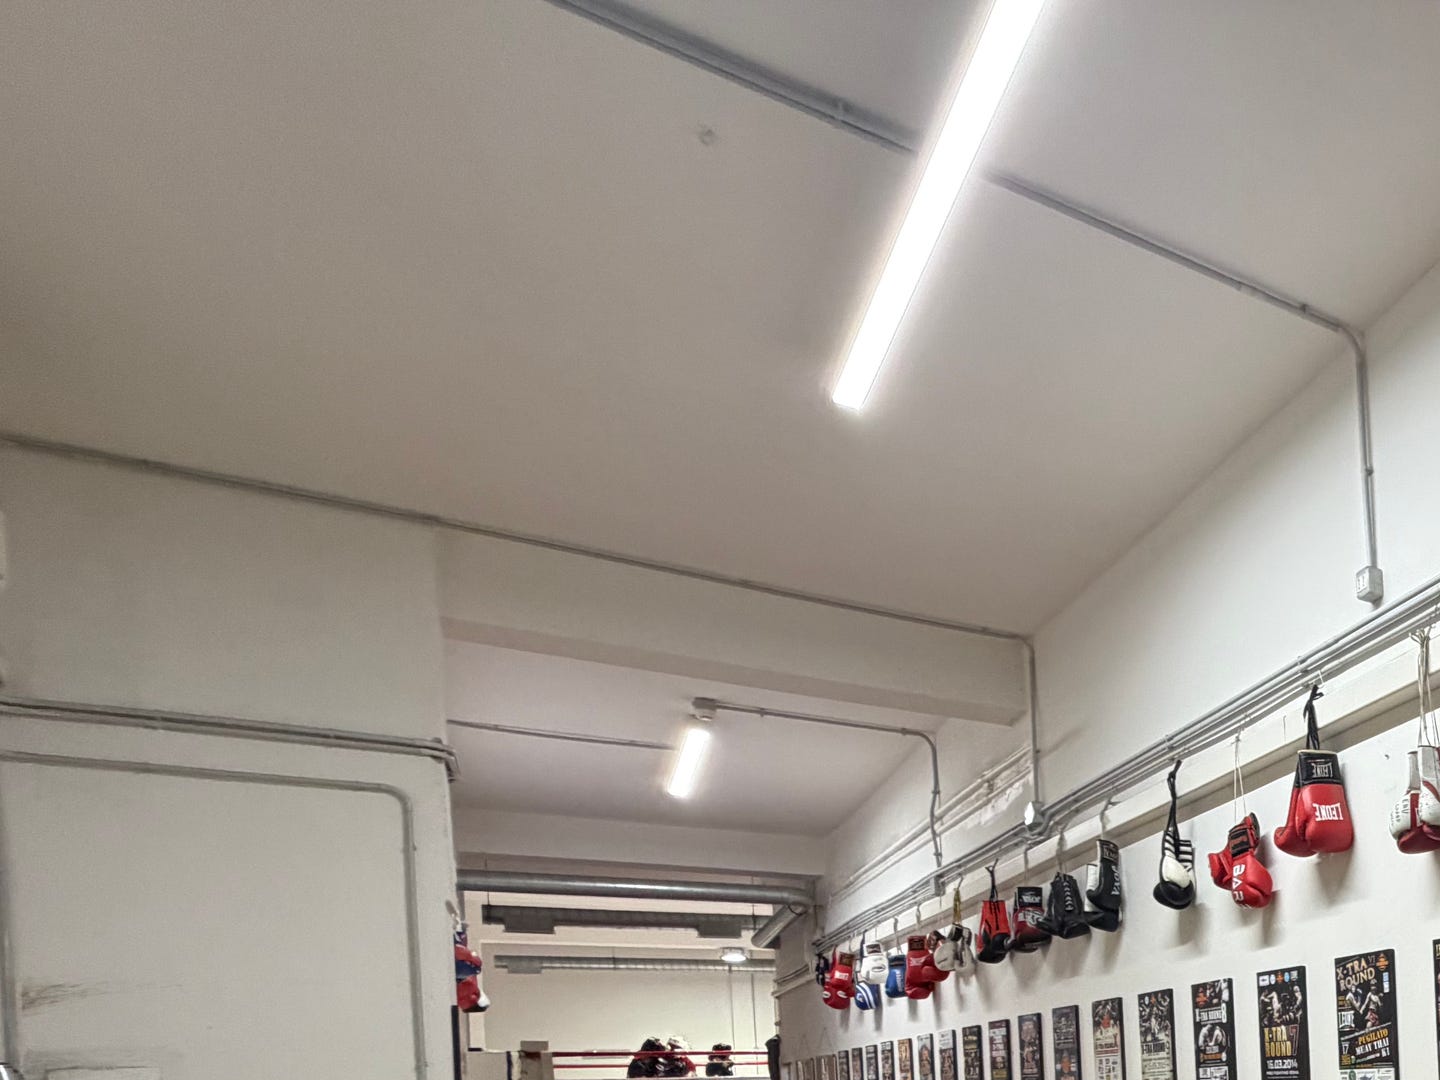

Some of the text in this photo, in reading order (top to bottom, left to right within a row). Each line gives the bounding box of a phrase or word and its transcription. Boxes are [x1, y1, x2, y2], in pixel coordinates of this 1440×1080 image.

[1311, 762, 1333, 778] LEONE
[1312, 802, 1344, 822] LEONE
[1336, 958, 1368, 979] X-TRA
[1340, 967, 1375, 992] ROUND
[1359, 1029, 1389, 1045] PUGILATO
[1374, 1037, 1389, 1050] THAI
[1265, 1041, 1291, 1057] ROUND
